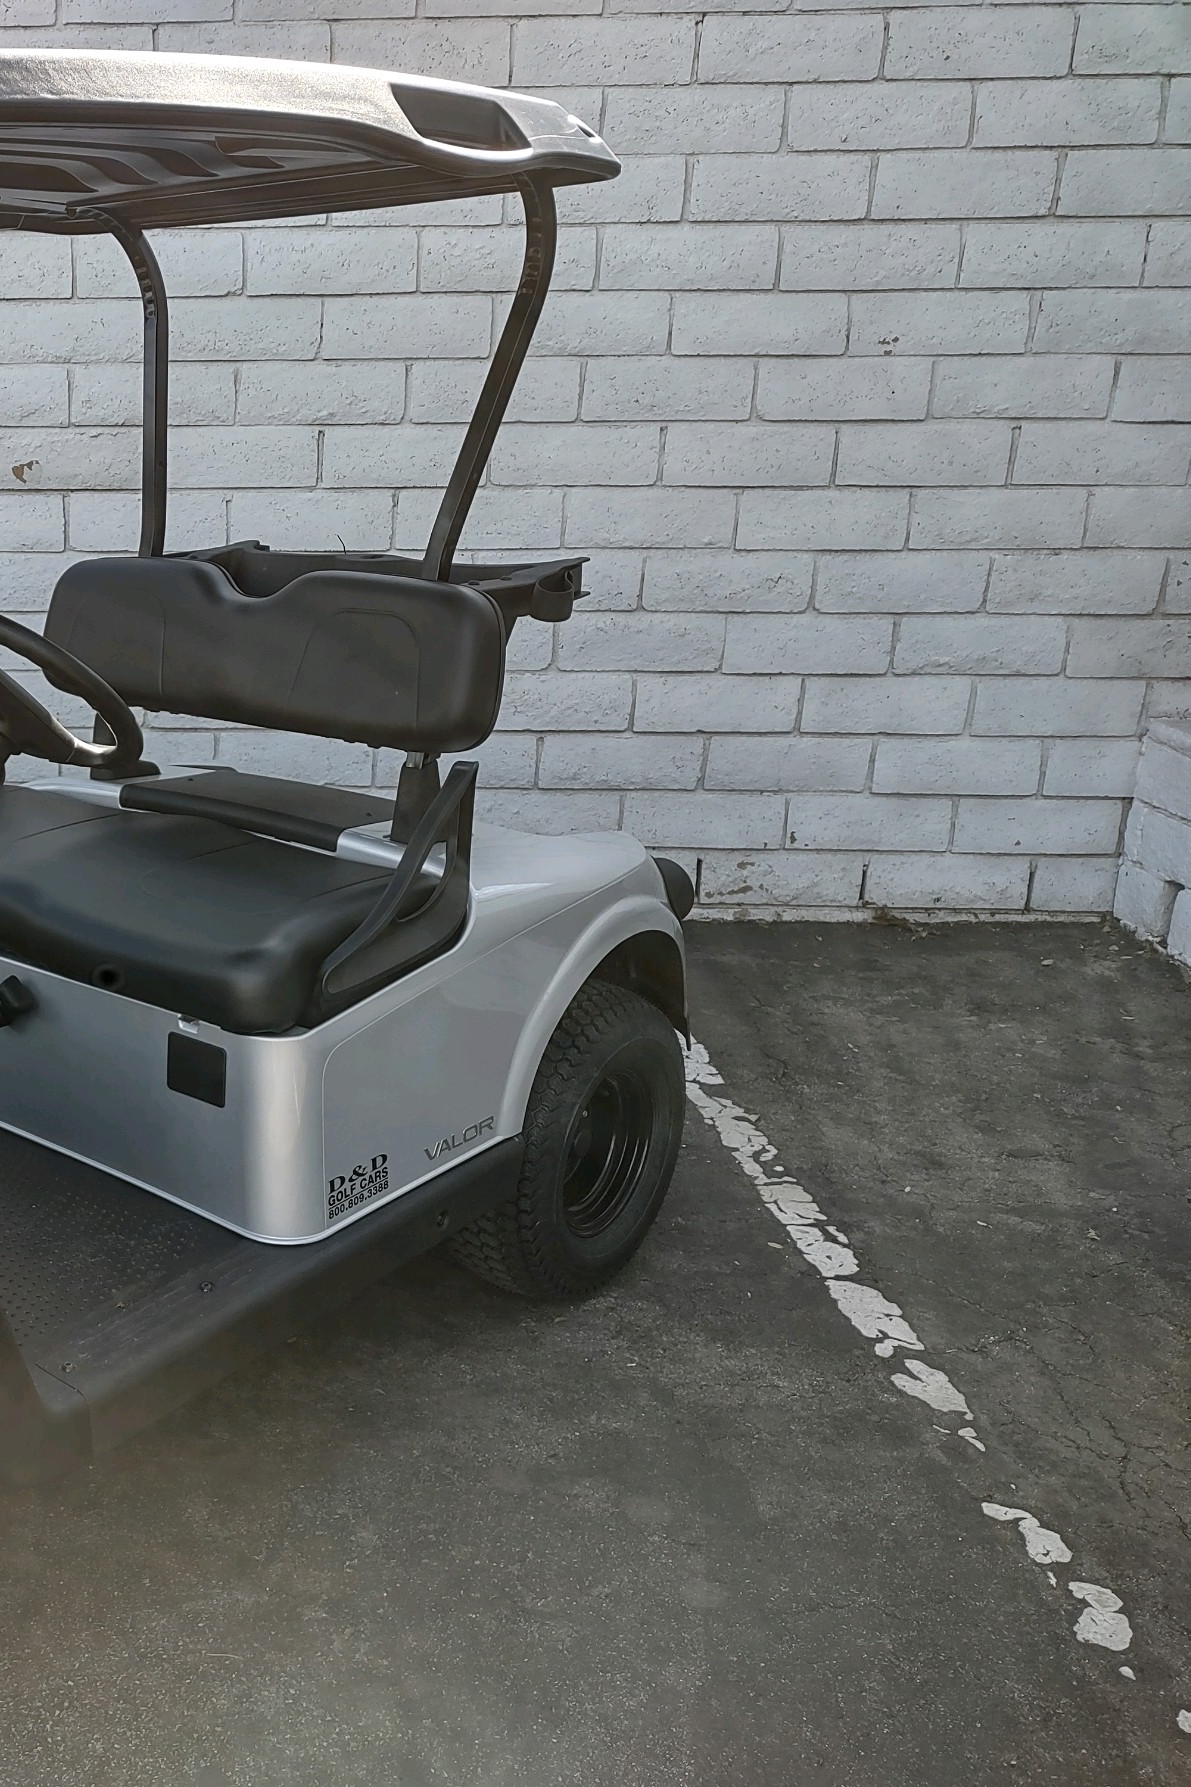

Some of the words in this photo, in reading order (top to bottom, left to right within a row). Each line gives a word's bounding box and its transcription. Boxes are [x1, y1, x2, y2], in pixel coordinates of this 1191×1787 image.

[424, 1115, 494, 1161] VALOR
[328, 1183, 356, 1207] GOLF
[360, 1167, 388, 1189] CARS
[328, 1180, 389, 1220] 800.809.3388
